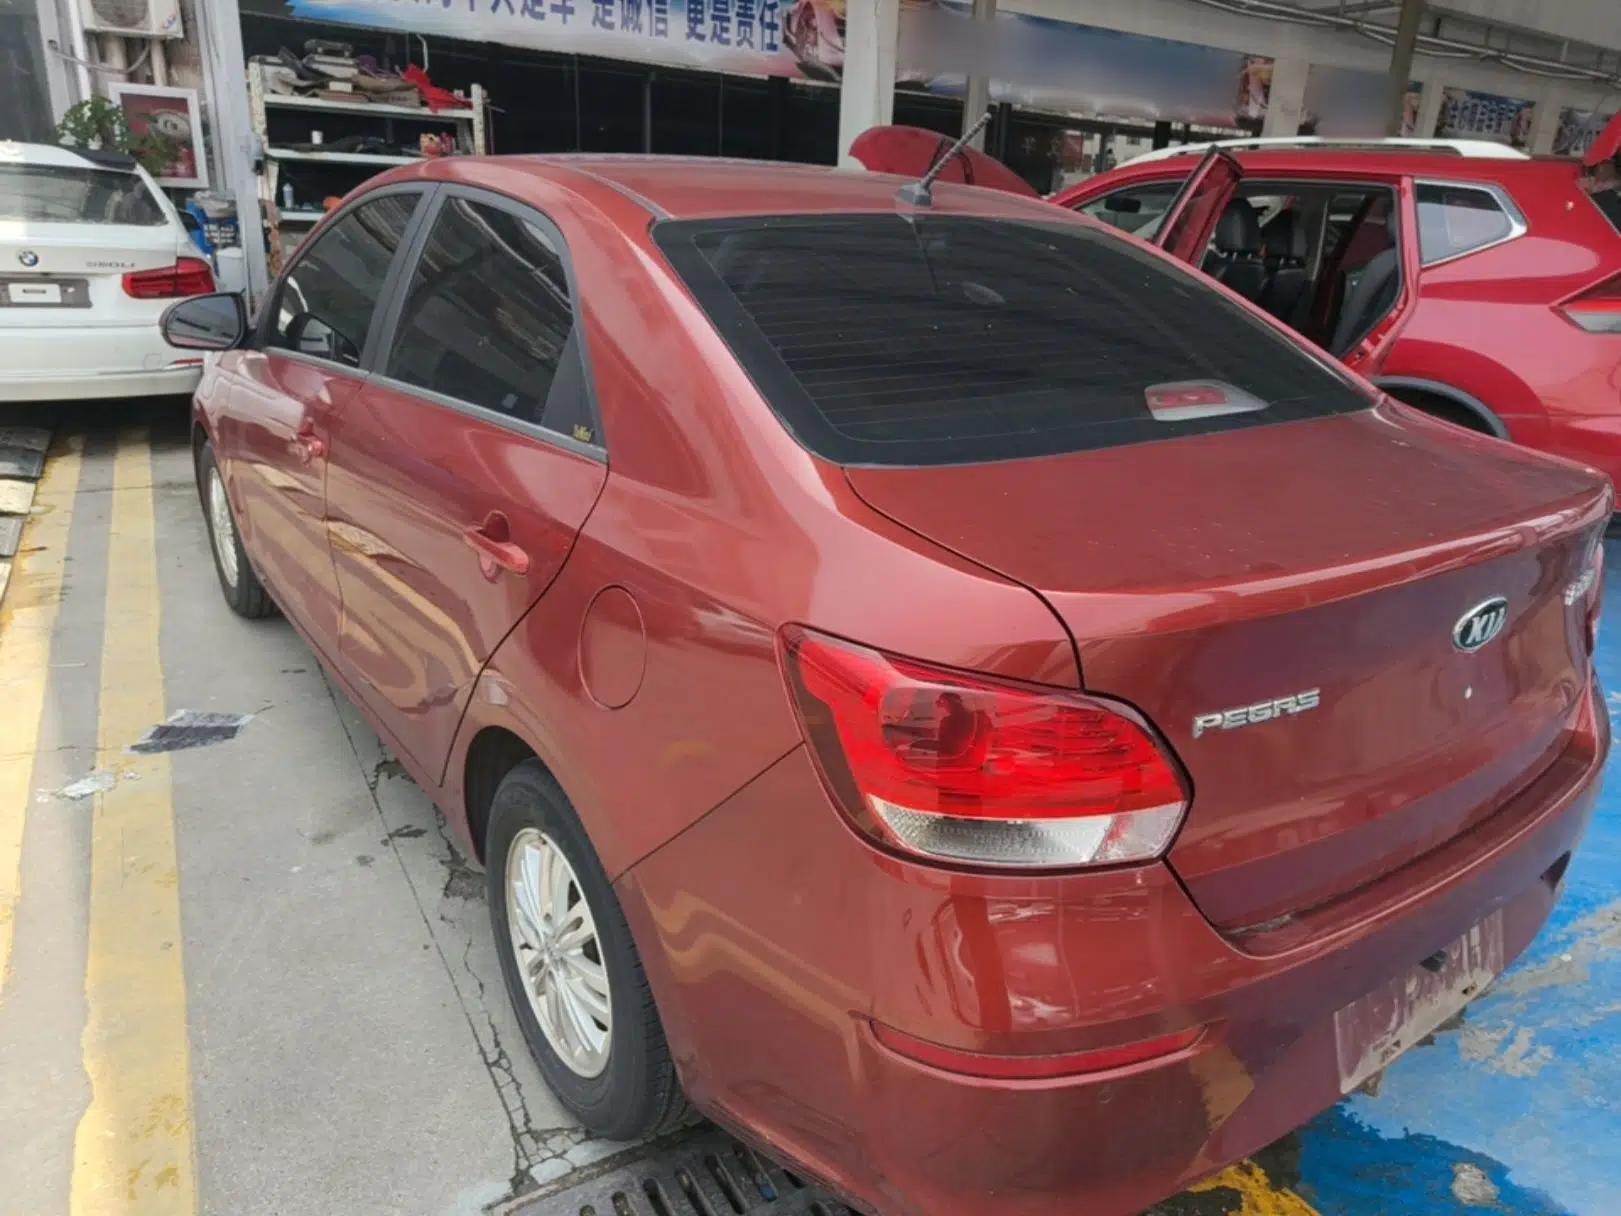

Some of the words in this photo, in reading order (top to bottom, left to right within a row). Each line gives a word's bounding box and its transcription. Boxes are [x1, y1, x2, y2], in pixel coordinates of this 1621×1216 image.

[685, 0, 779, 51] 更是责任
[1465, 606, 1506, 644] KIA
[1193, 687, 1321, 738] PEGAS
